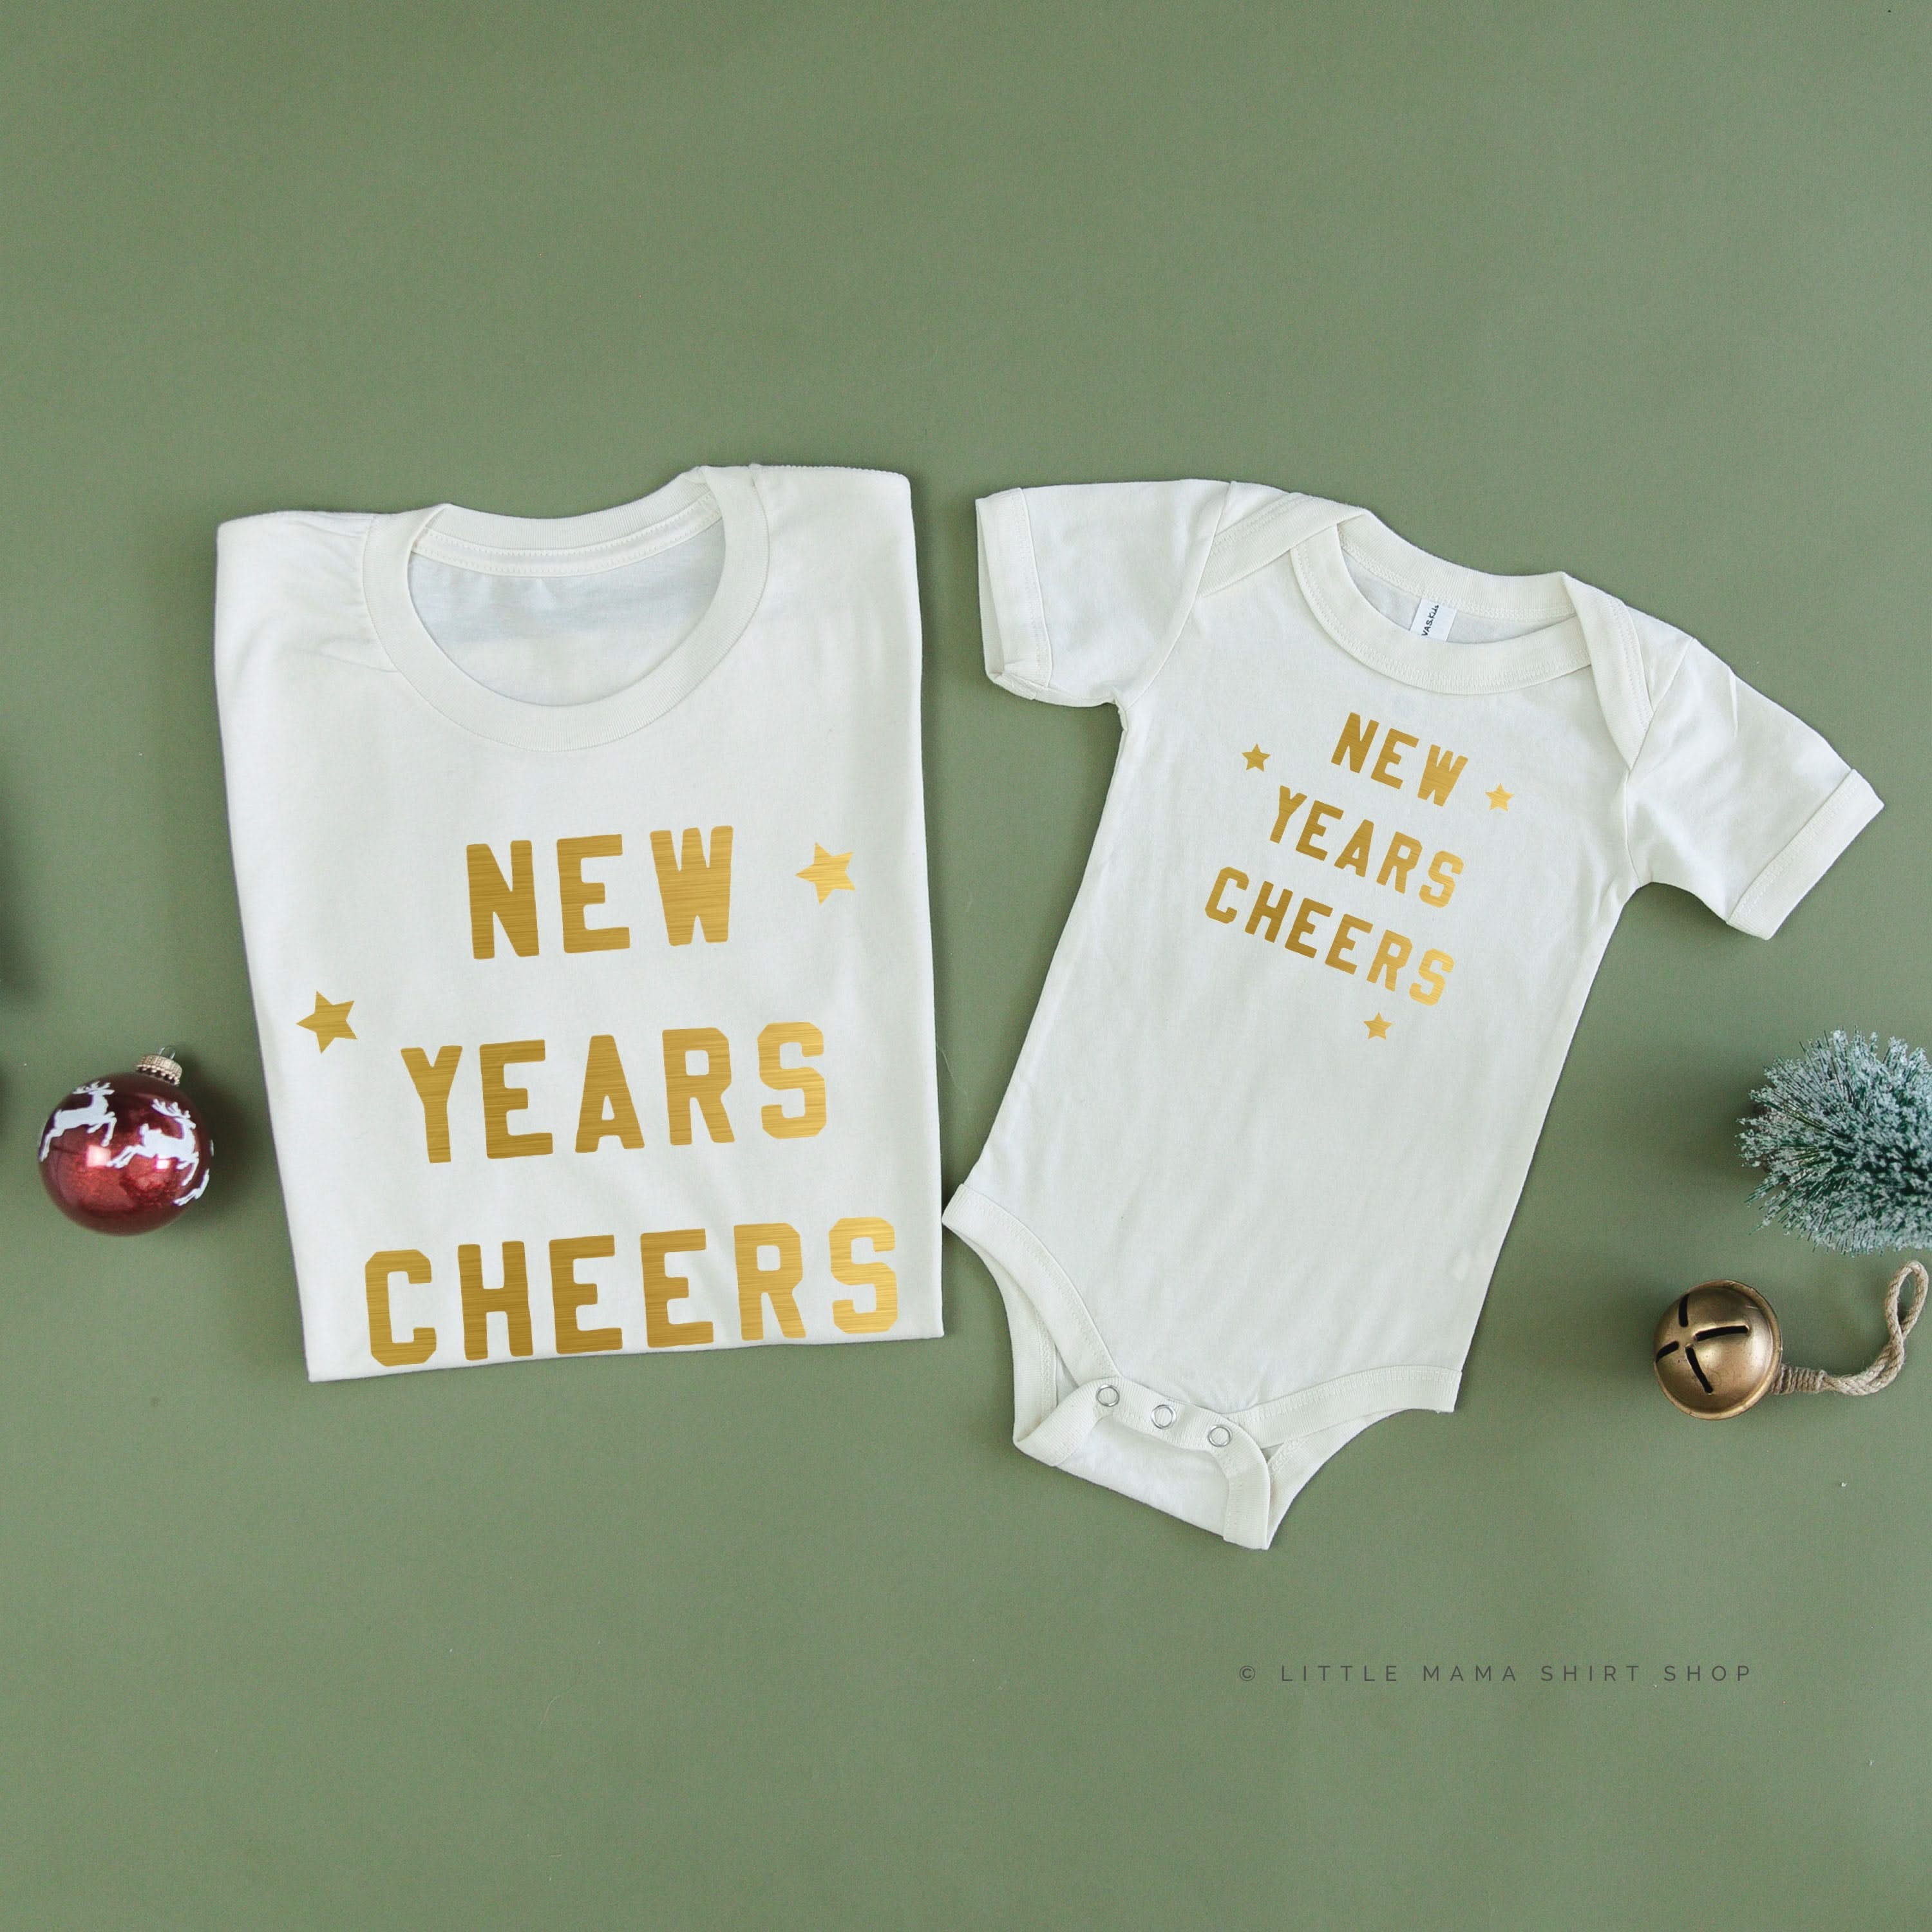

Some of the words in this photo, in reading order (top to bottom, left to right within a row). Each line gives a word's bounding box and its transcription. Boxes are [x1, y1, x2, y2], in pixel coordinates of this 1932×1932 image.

[1331, 713, 1468, 806] NEW
[467, 826, 733, 959] NEW
[1271, 786, 1463, 907] YEARS
[1206, 867, 1454, 1005] CHEERS
[401, 1022, 826, 1163] YEARS
[365, 1218, 897, 1367] CHEERS
